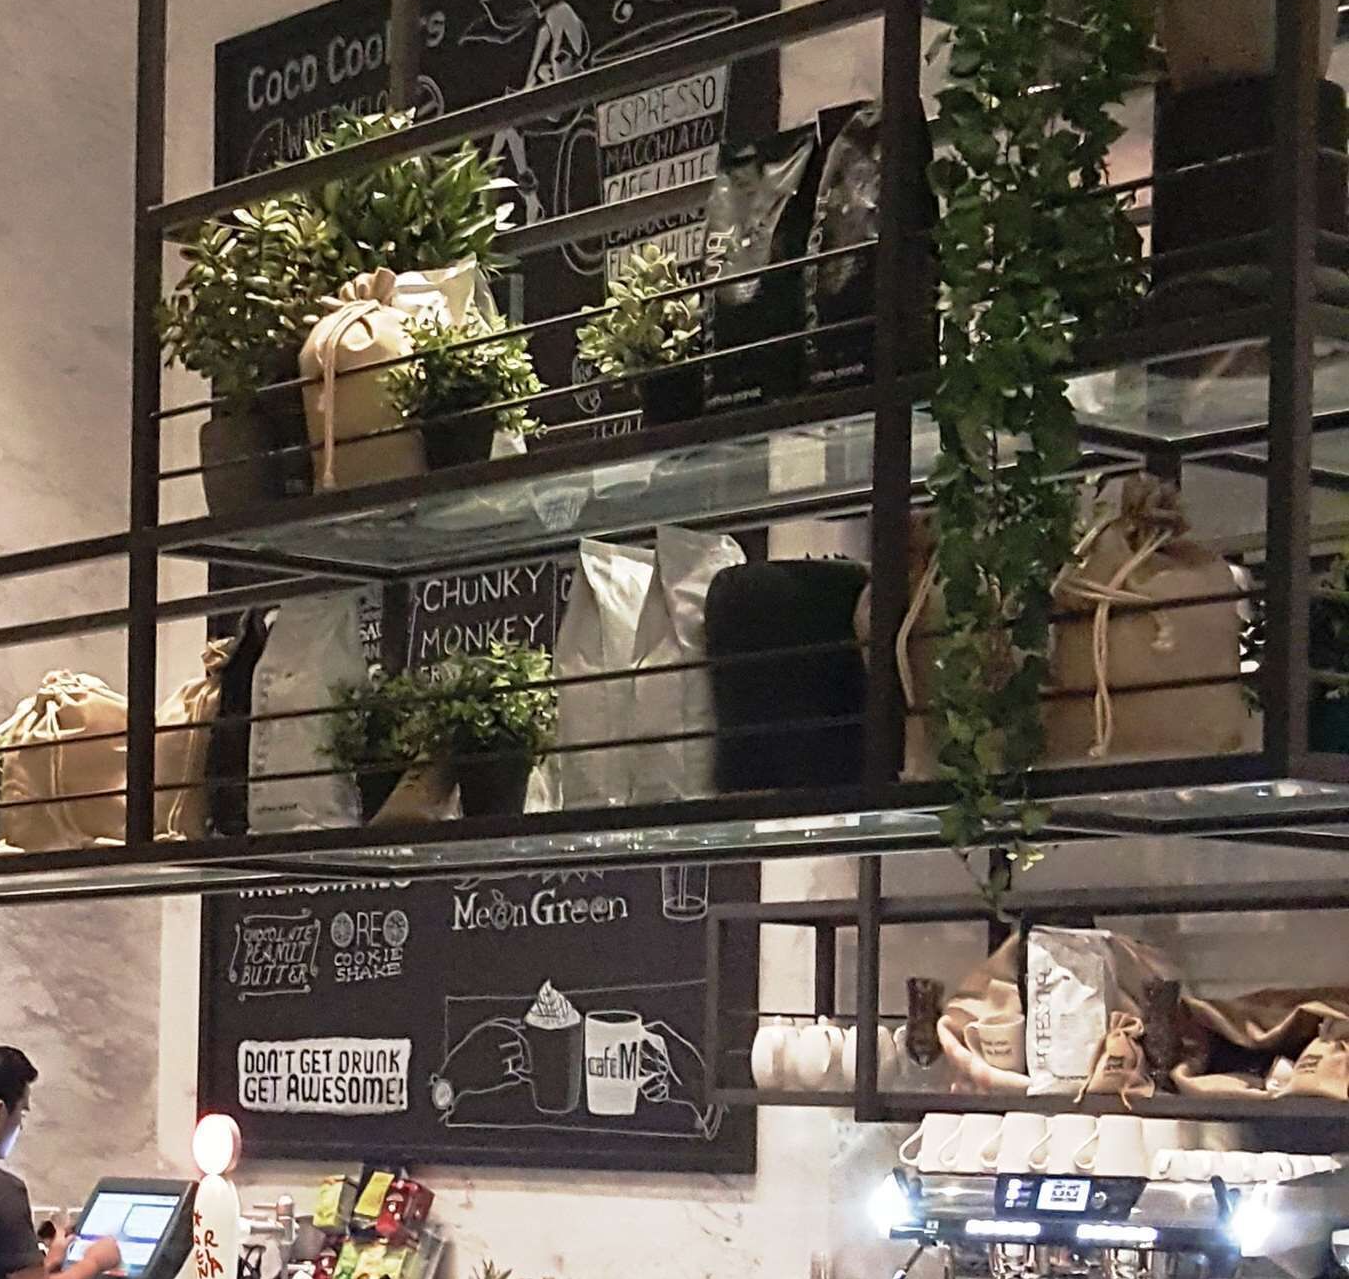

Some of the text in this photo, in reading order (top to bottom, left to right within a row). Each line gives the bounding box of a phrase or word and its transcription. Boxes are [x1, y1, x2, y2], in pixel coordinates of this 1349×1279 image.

[605, 76, 717, 142] ESPRESSO
[605, 117, 715, 175] MACCHIATO
[423, 562, 547, 612] CHUNKY
[420, 613, 545, 659] MONKEY
[244, 942, 312, 964] PEANUT
[334, 948, 404, 966] COOKIE
[241, 960, 309, 986] BUTTER
[335, 962, 402, 982] SHAKE
[300, 1049, 332, 1074] GET
[339, 1049, 401, 1074] DRUNK
[244, 1073, 404, 1105] GET AWESOME!
